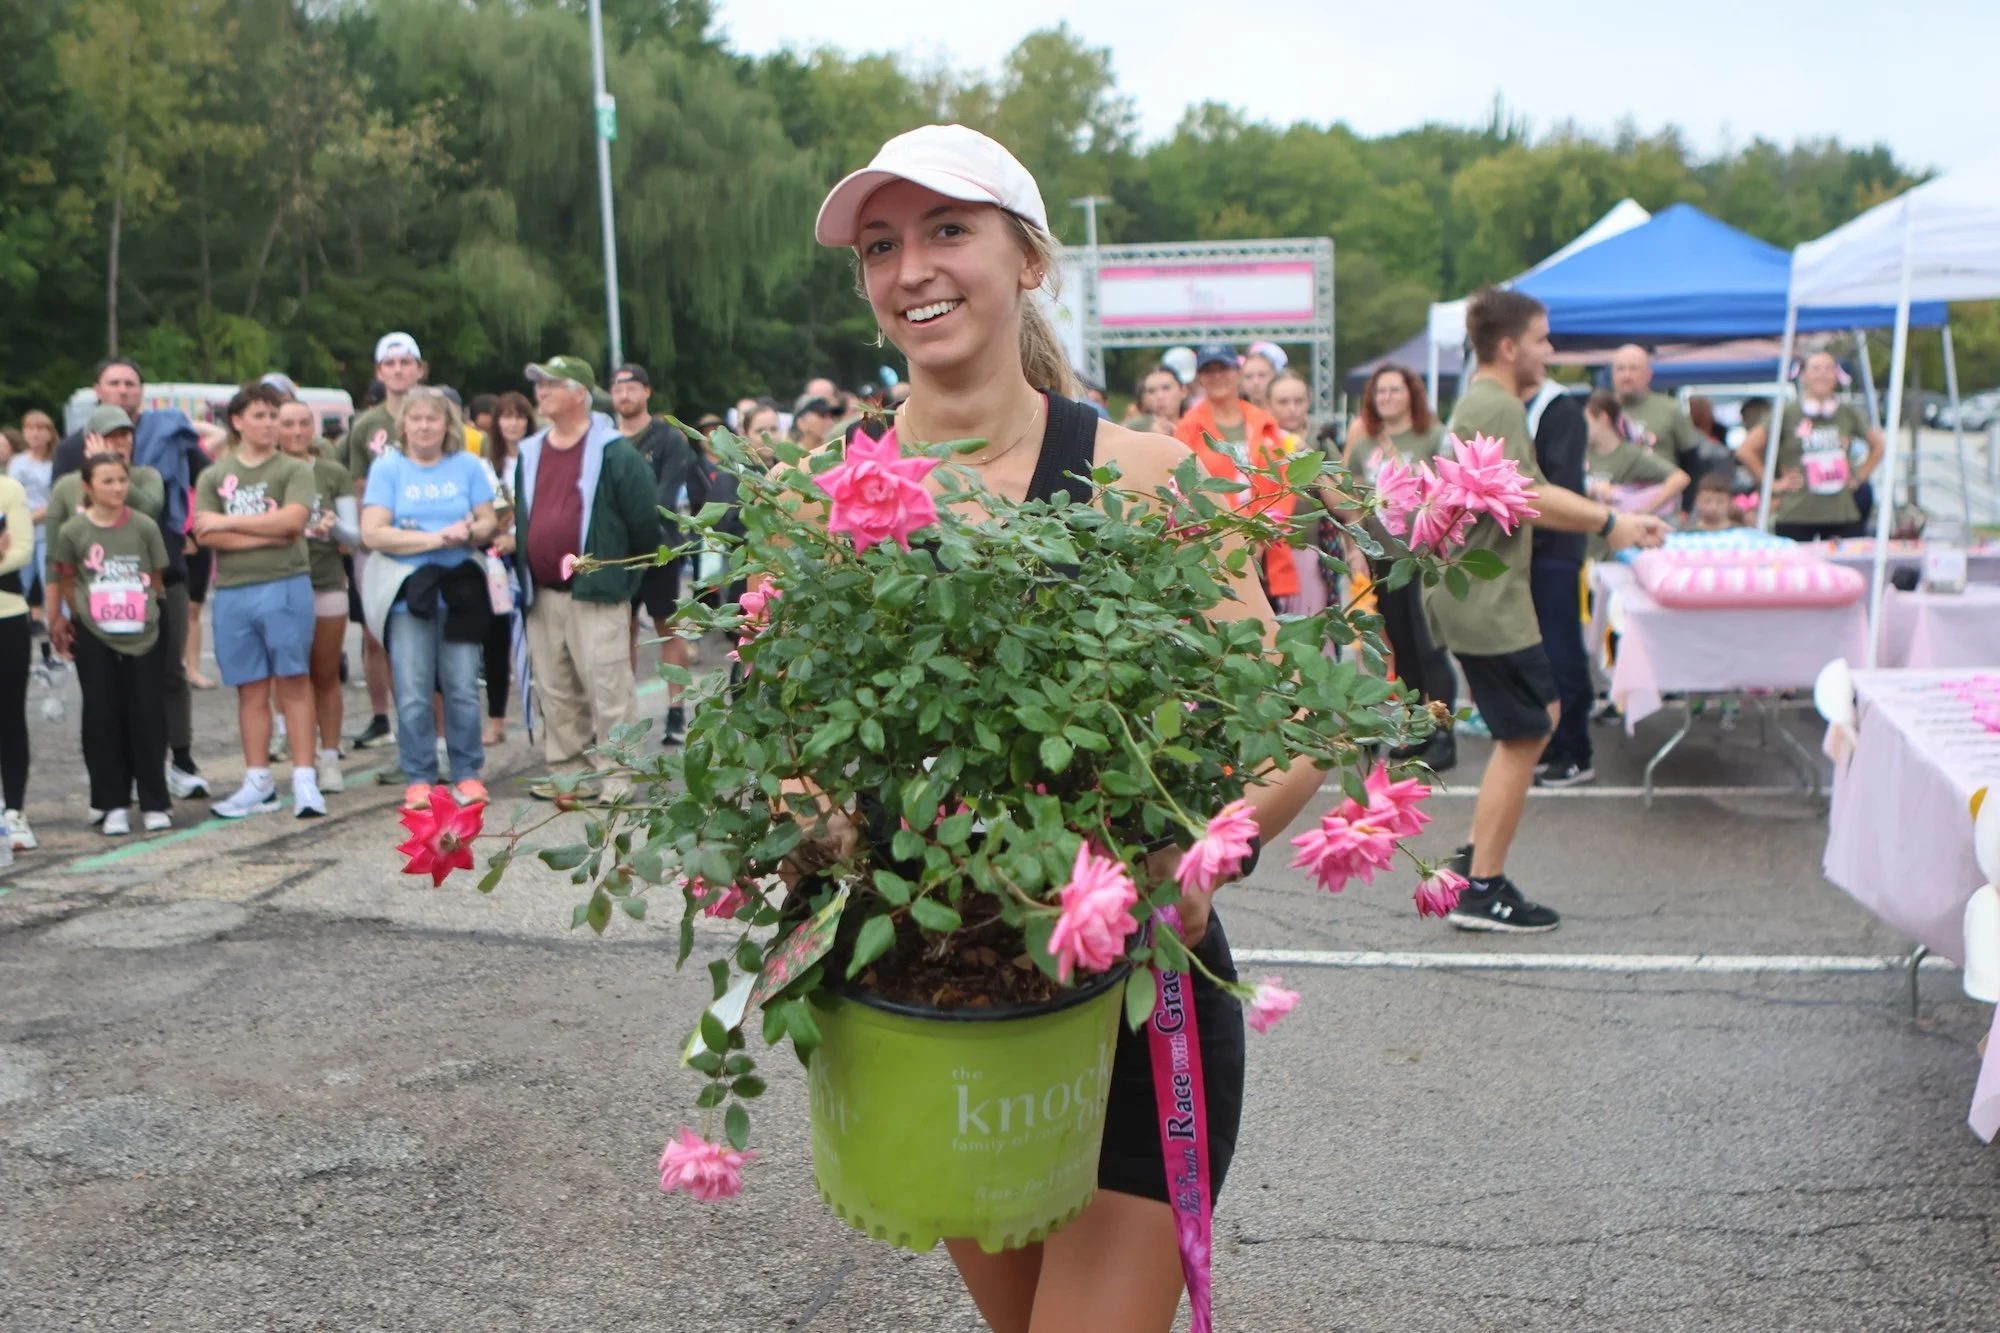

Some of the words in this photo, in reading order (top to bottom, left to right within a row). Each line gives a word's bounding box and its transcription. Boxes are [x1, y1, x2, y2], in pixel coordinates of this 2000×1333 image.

[100, 603, 137, 621] 620
[1154, 968, 1185, 1035] Grac
[951, 1066, 983, 1081] the
[1166, 1072, 1196, 1142] Race
[951, 1136, 1006, 1154] family
